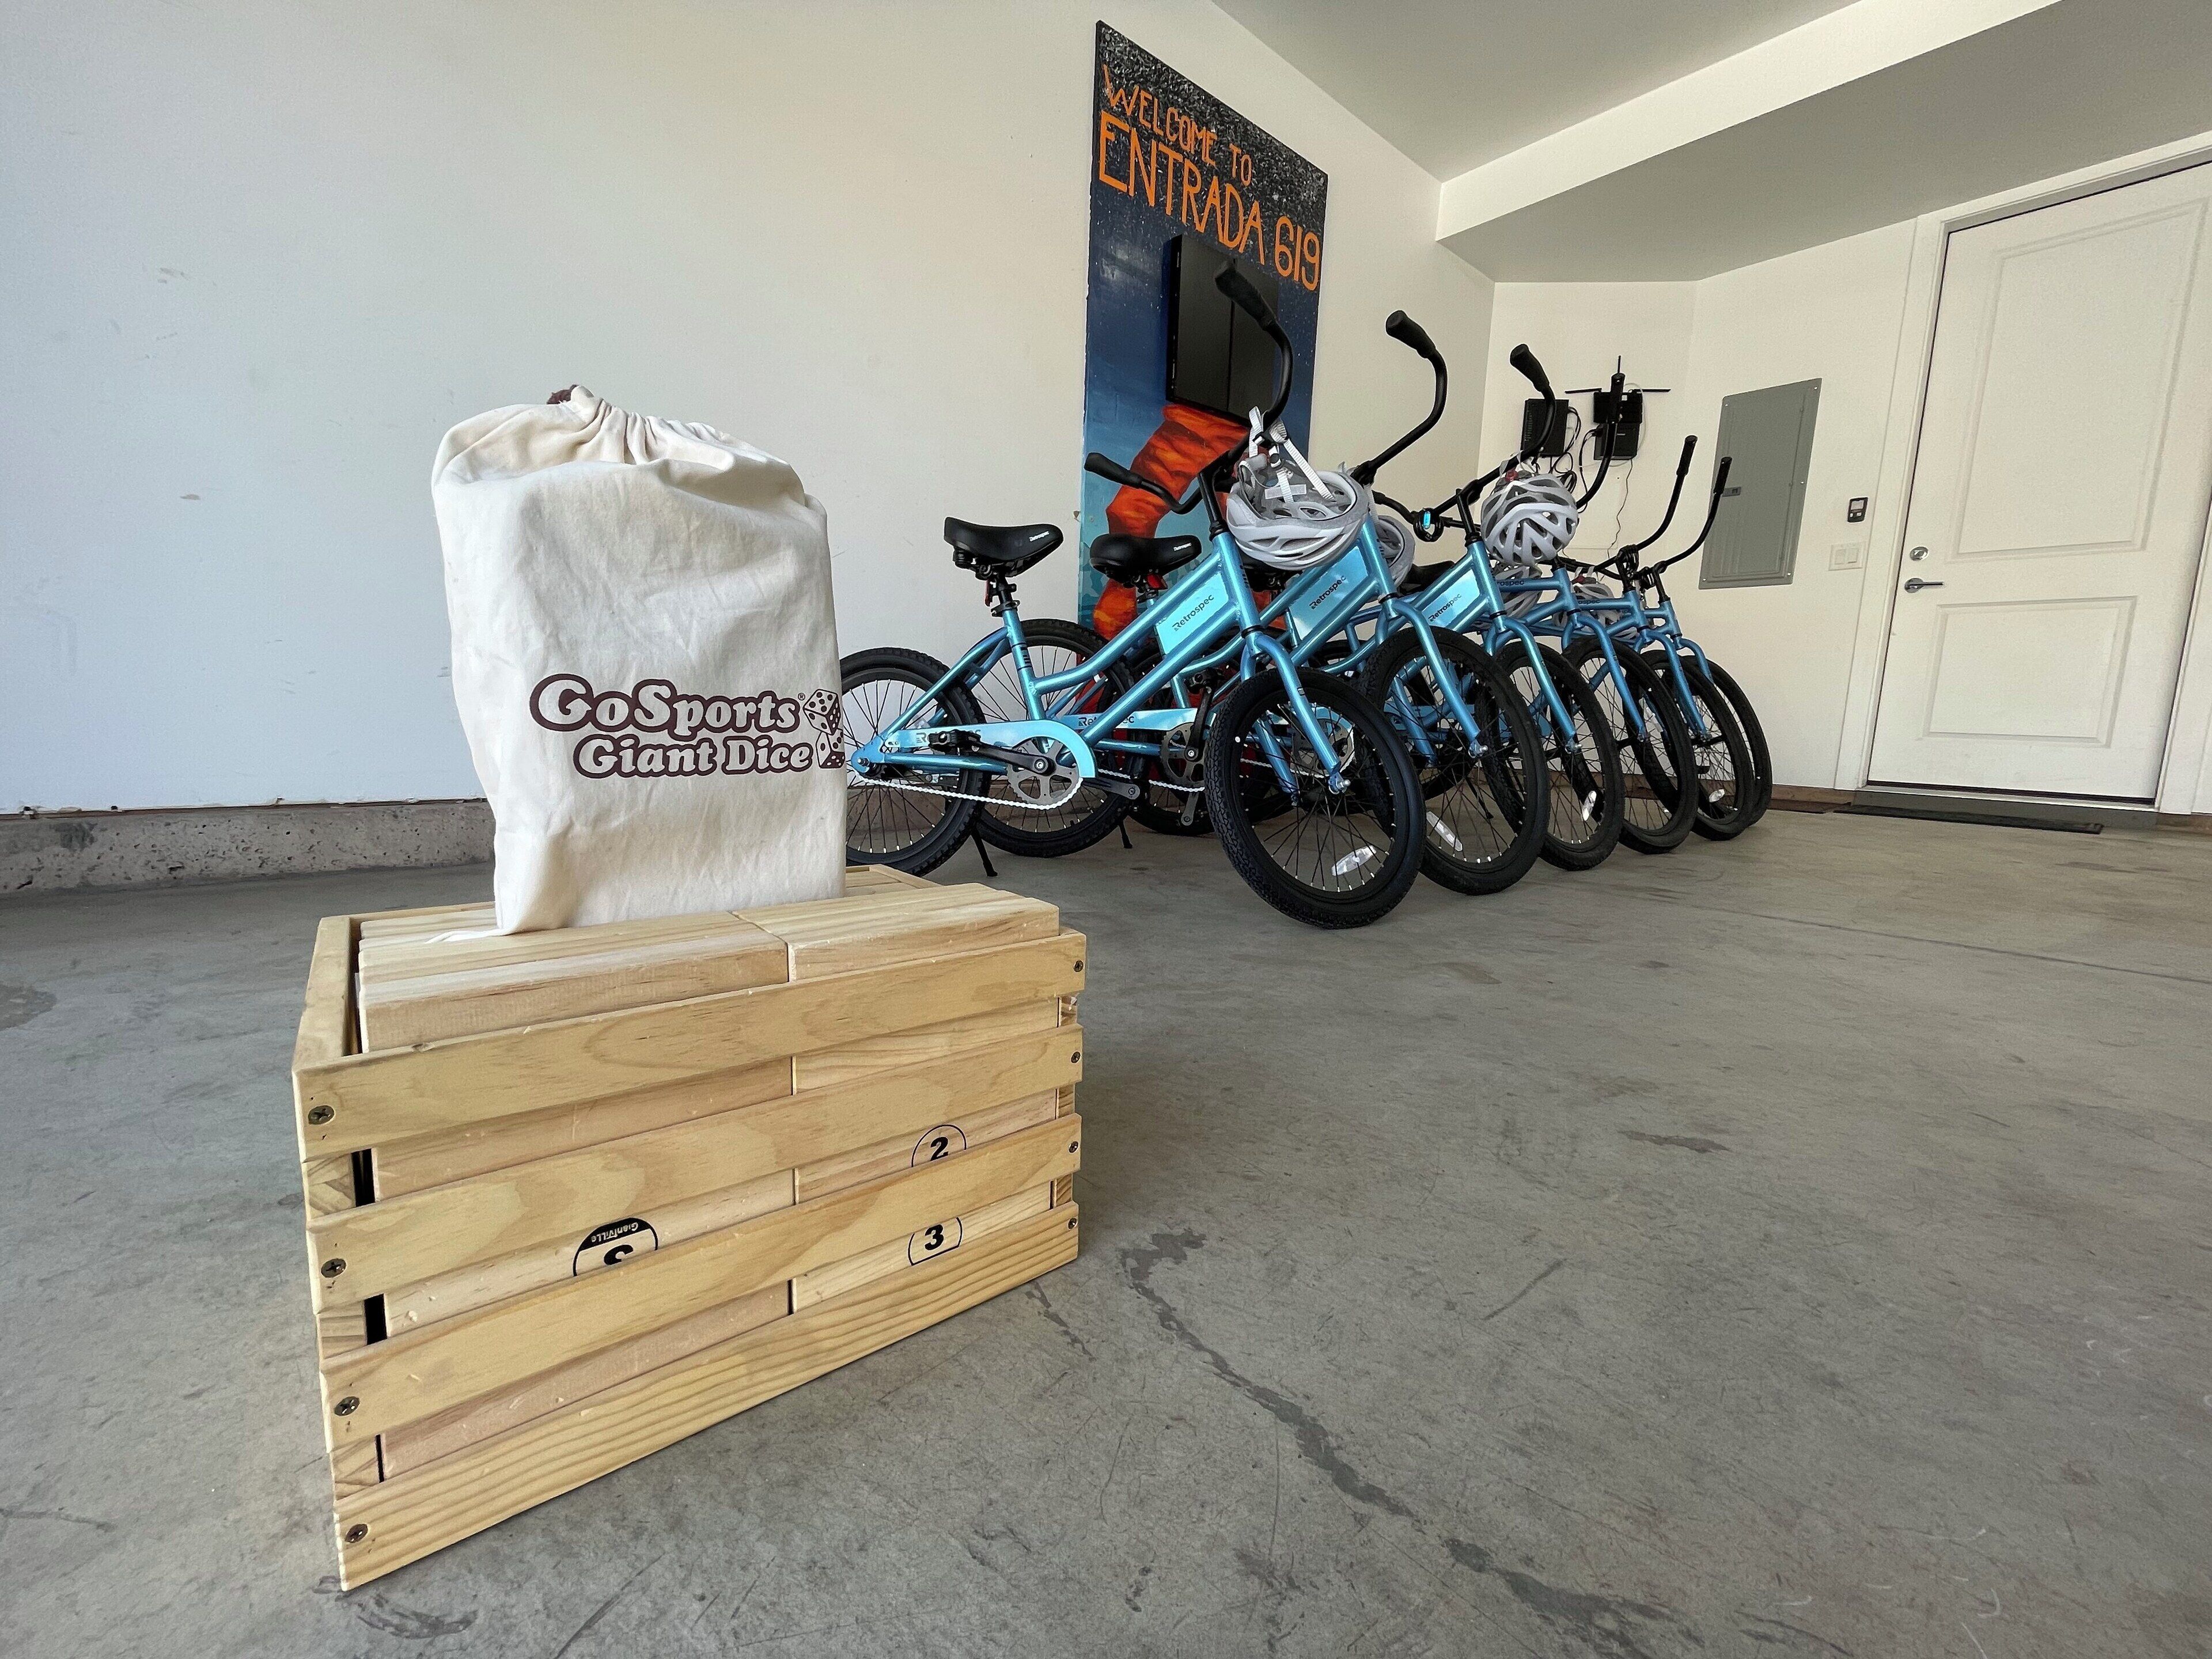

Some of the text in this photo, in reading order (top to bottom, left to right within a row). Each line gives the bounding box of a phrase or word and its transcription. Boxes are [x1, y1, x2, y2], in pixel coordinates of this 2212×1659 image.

[1103, 63, 1252, 186] WELCOME TO
[1098, 109, 1320, 291] ENTRADA 619
[1308, 575, 1347, 610] Retrospec
[1427, 593, 1462, 622] Retrospec
[1172, 594, 1215, 632] Retrospec
[573, 734, 813, 779] Giant Dice
[930, 1136, 949, 1161] 2
[924, 1224, 944, 1251] 3
